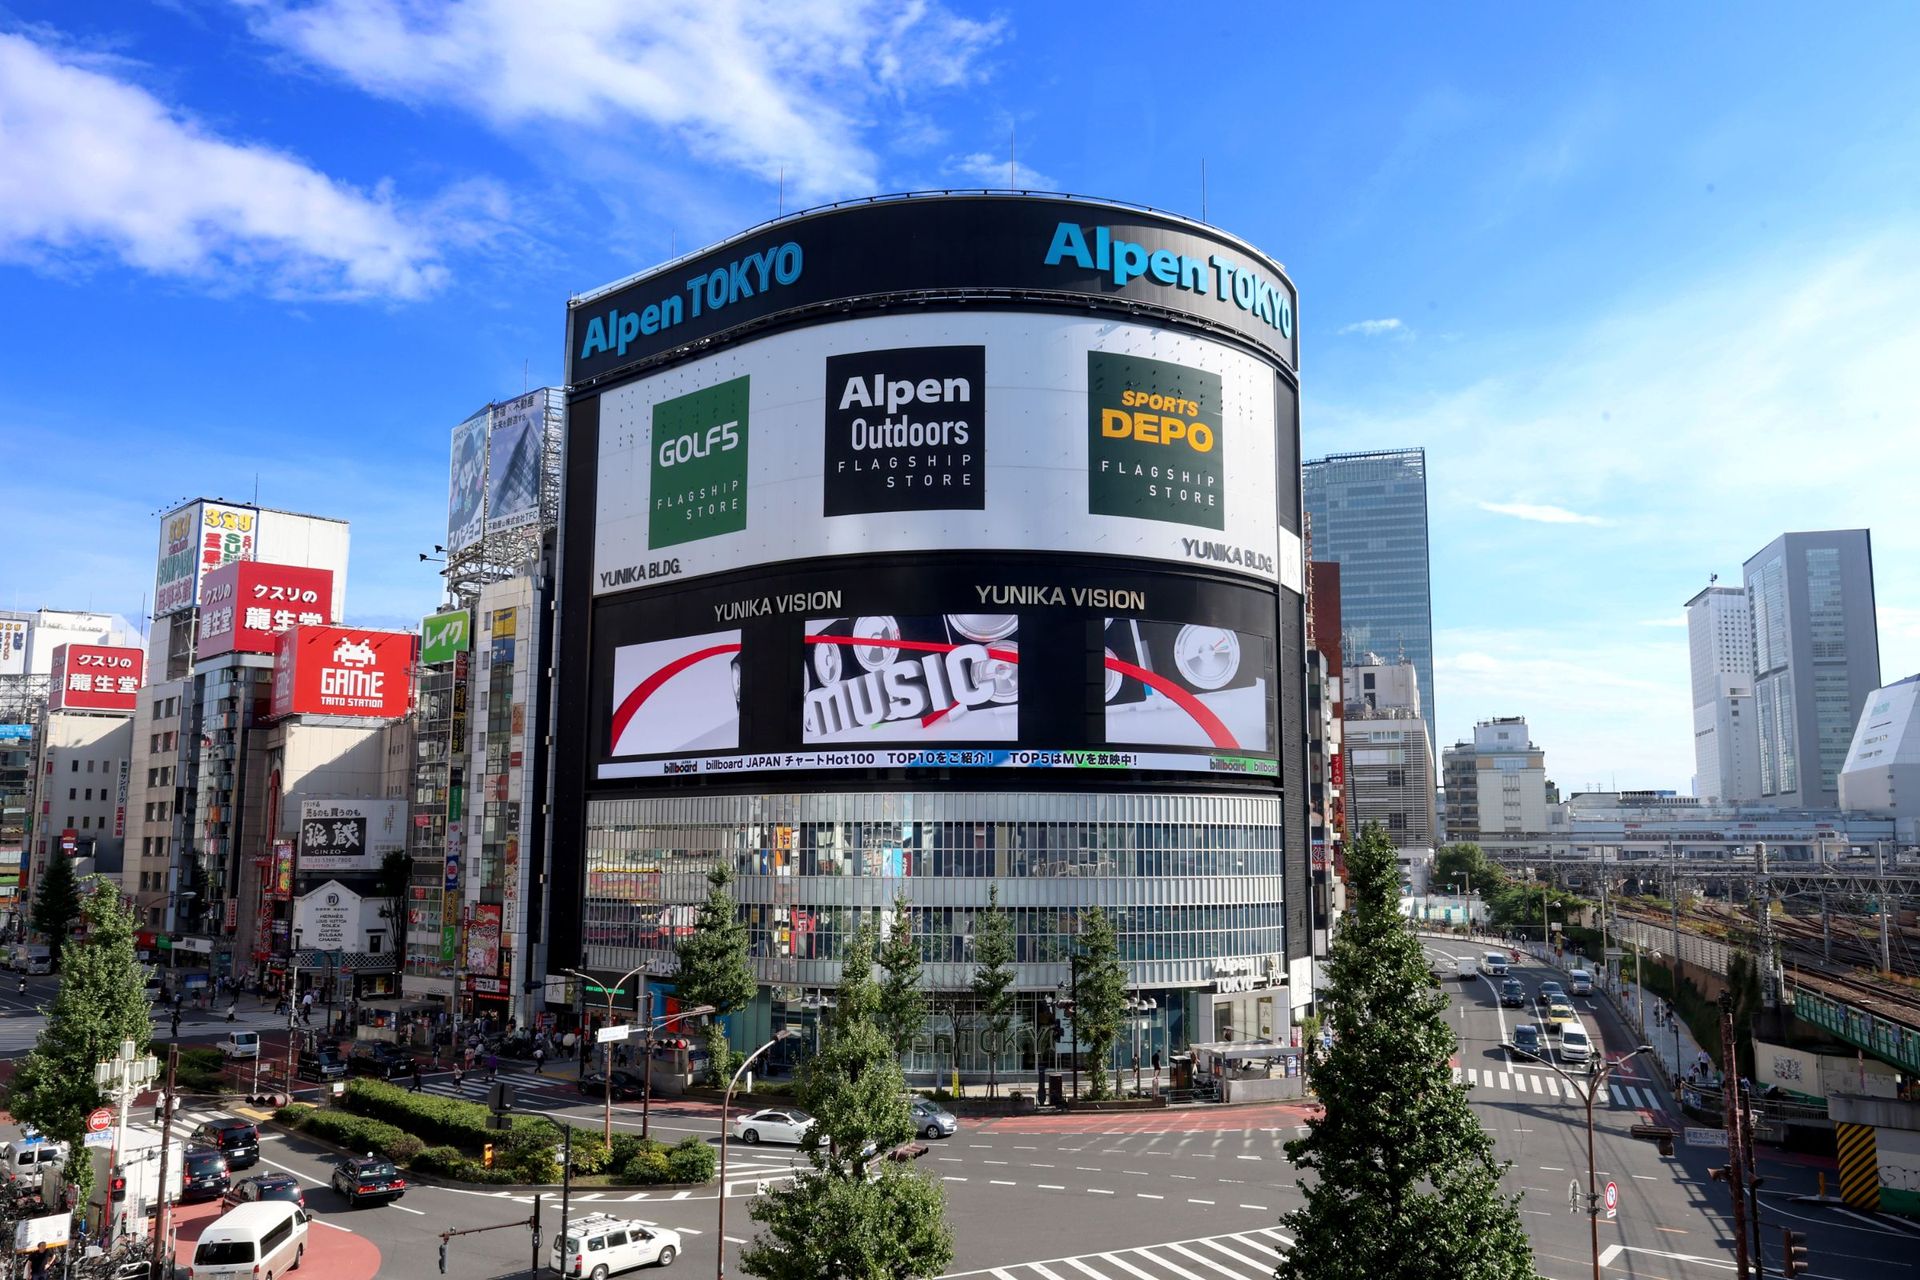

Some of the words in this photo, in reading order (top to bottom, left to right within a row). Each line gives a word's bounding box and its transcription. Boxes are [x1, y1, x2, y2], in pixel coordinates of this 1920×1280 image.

[1044, 222, 1207, 294] Alpen
[1212, 254, 1293, 339] TOKYO
[581, 293, 683, 360] Alpen
[686, 241, 804, 319] TOKYO
[839, 374, 971, 412] Alpen
[1121, 389, 1199, 417] SPORTS
[658, 419, 740, 469] GOLF5
[851, 414, 969, 451] Outdoors
[1101, 409, 1214, 454] DEPO
[838, 453, 971, 474] FLAGSHIP
[1101, 459, 1216, 487] FLAGSHIP
[886, 473, 971, 488] STORE
[656, 478, 739, 511] FLAGSHIP
[1148, 484, 1216, 507] STORE
[686, 498, 739, 521] STORE
[1181, 537, 1245, 565] YUNIKA
[1244, 548, 1275, 575] BLDG.
[599, 562, 648, 588] YUNIKA
[648, 557, 682, 580] BLDG.
[205, 583, 232, 606] クスリの
[253, 584, 318, 604] クスリの
[714, 598, 773, 623] YUNIKA
[775, 590, 842, 617] VISION
[974, 585, 1067, 608] YUNIKA
[1071, 587, 1146, 610] VISION
[244, 607, 323, 633] 龍生堂
[425, 620, 463, 649] レイク
[77, 654, 132, 668] クスリの
[68, 673, 139, 694] 龍生堂
[320, 667, 385, 698] GAME
[806, 642, 996, 738] MUSIC
[320, 696, 345, 707] TAITO
[347, 697, 384, 708] STATION
[663, 761, 698, 774] billboard
[705, 758, 744, 770] billboard
[746, 755, 781, 768] JAPAN
[784, 753, 875, 767] チャートHot100
[886, 752, 993, 765] TOP10をご紹介!
[1009, 752, 1138, 766] TOP5はMVを放映中!
[1209, 758, 1247, 772] billboard
[443, 931, 452, 954] レイク
[1214, 956, 1251, 976] Alpen
[1214, 977, 1254, 993] TOKYO
